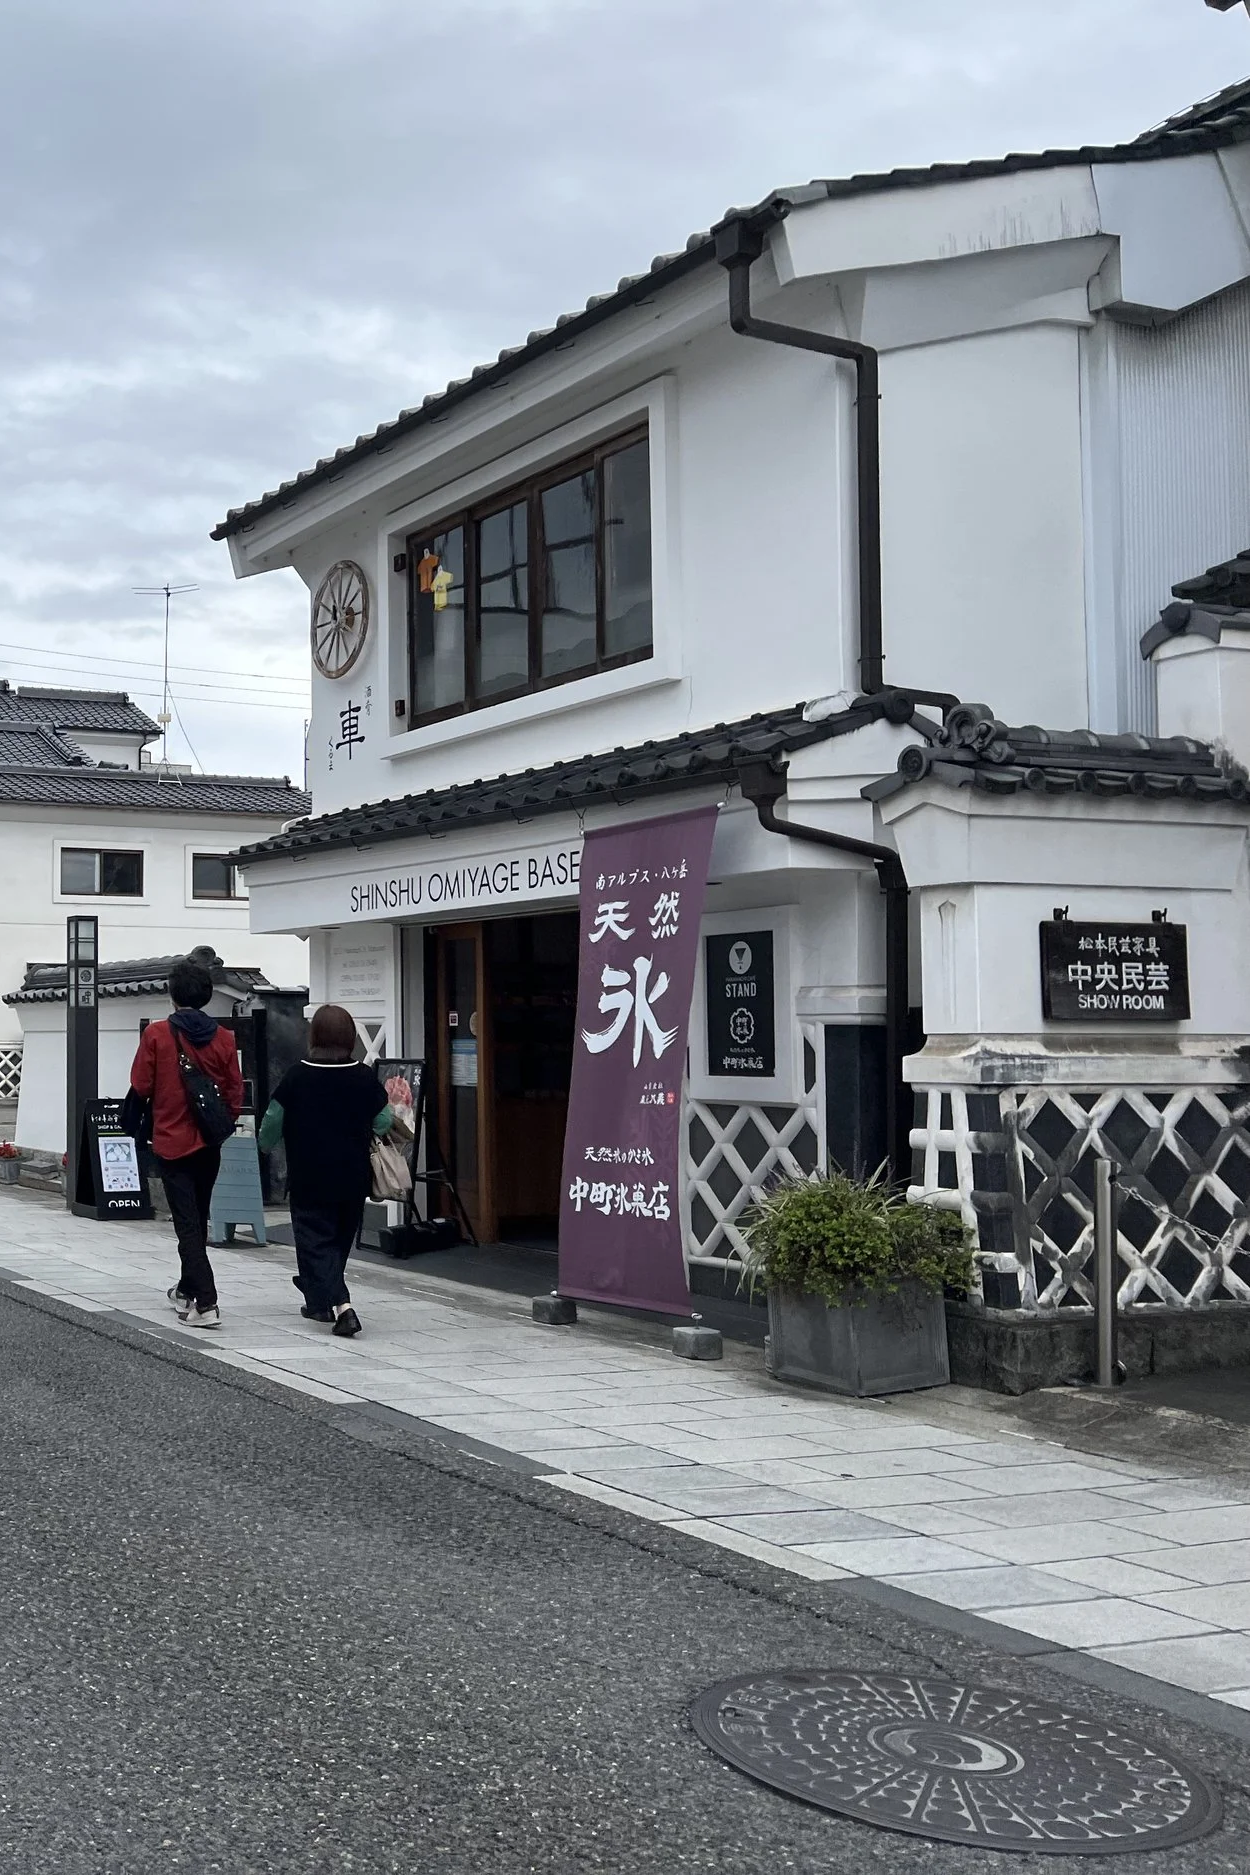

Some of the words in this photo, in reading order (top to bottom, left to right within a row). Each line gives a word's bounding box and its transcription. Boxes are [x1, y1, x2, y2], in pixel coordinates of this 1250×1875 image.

[335, 700, 365, 760] 車
[350, 875, 422, 913] SHINSHU
[428, 860, 520, 902] OMIYAGE
[528, 850, 581, 889] BASE
[588, 891, 680, 943] 天然
[725, 983, 757, 997] STAND
[1068, 961, 1170, 991] 中央民芸
[581, 953, 679, 1068] 氷
[1078, 995, 1120, 1009] SHOW
[1123, 995, 1165, 1010] ROOM
[569, 1176, 671, 1221] 中町氷菓店
